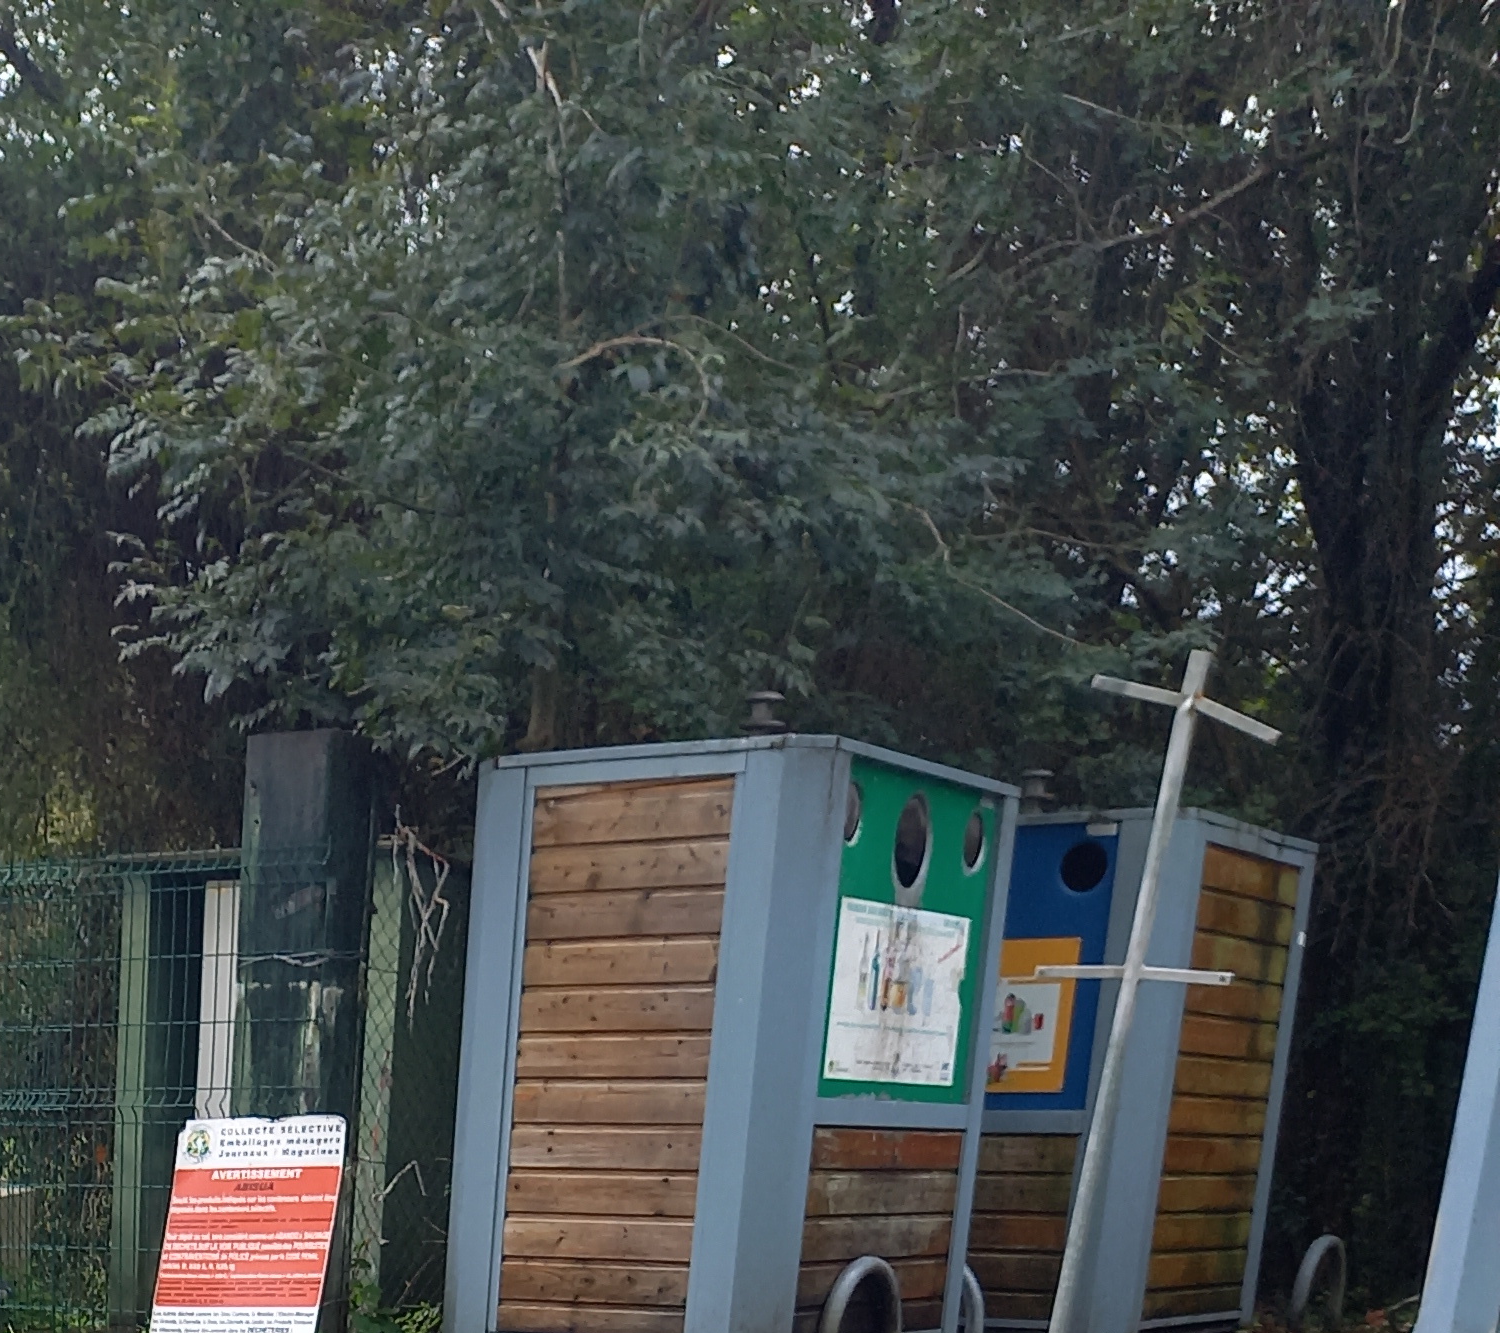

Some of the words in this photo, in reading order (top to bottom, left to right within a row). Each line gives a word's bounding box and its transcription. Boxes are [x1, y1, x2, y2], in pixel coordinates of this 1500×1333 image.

[221, 1127, 275, 1135] COLLECTE
[219, 1138, 281, 1147] Emballages
[218, 1149, 268, 1158] Journaux
[282, 1148, 340, 1157] Magazines
[211, 1169, 303, 1180] AVERTISSEMENT
